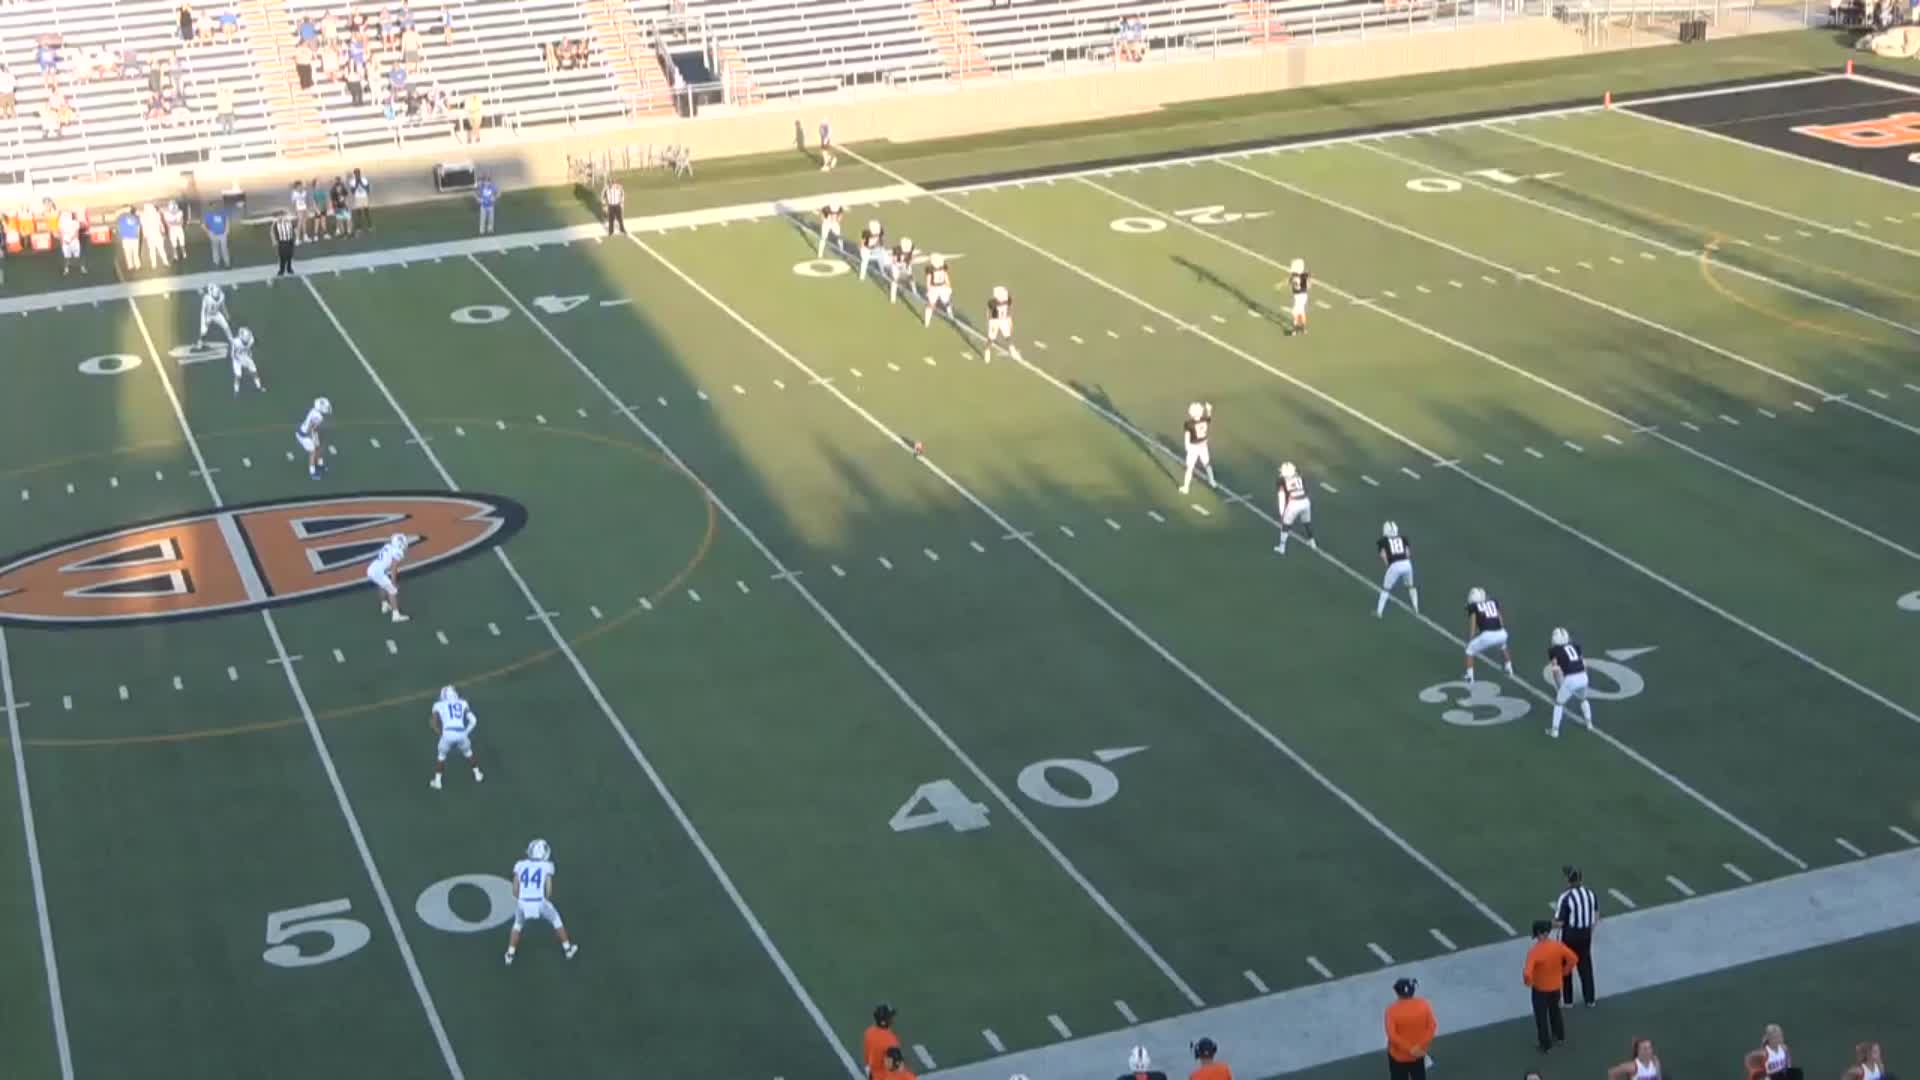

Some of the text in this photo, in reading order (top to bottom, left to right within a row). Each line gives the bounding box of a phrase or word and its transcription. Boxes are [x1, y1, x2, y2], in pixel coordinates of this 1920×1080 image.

[1109, 204, 1243, 234] 20
[450, 294, 590, 325] 40
[1388, 536, 1405, 555] 18
[1477, 600, 1498, 619] 40
[1563, 644, 1579, 662] 0
[1419, 657, 1645, 726] 30
[447, 703, 463, 720] 19
[889, 758, 1119, 832] 40
[519, 867, 543, 889] 44
[263, 873, 516, 968] 50
